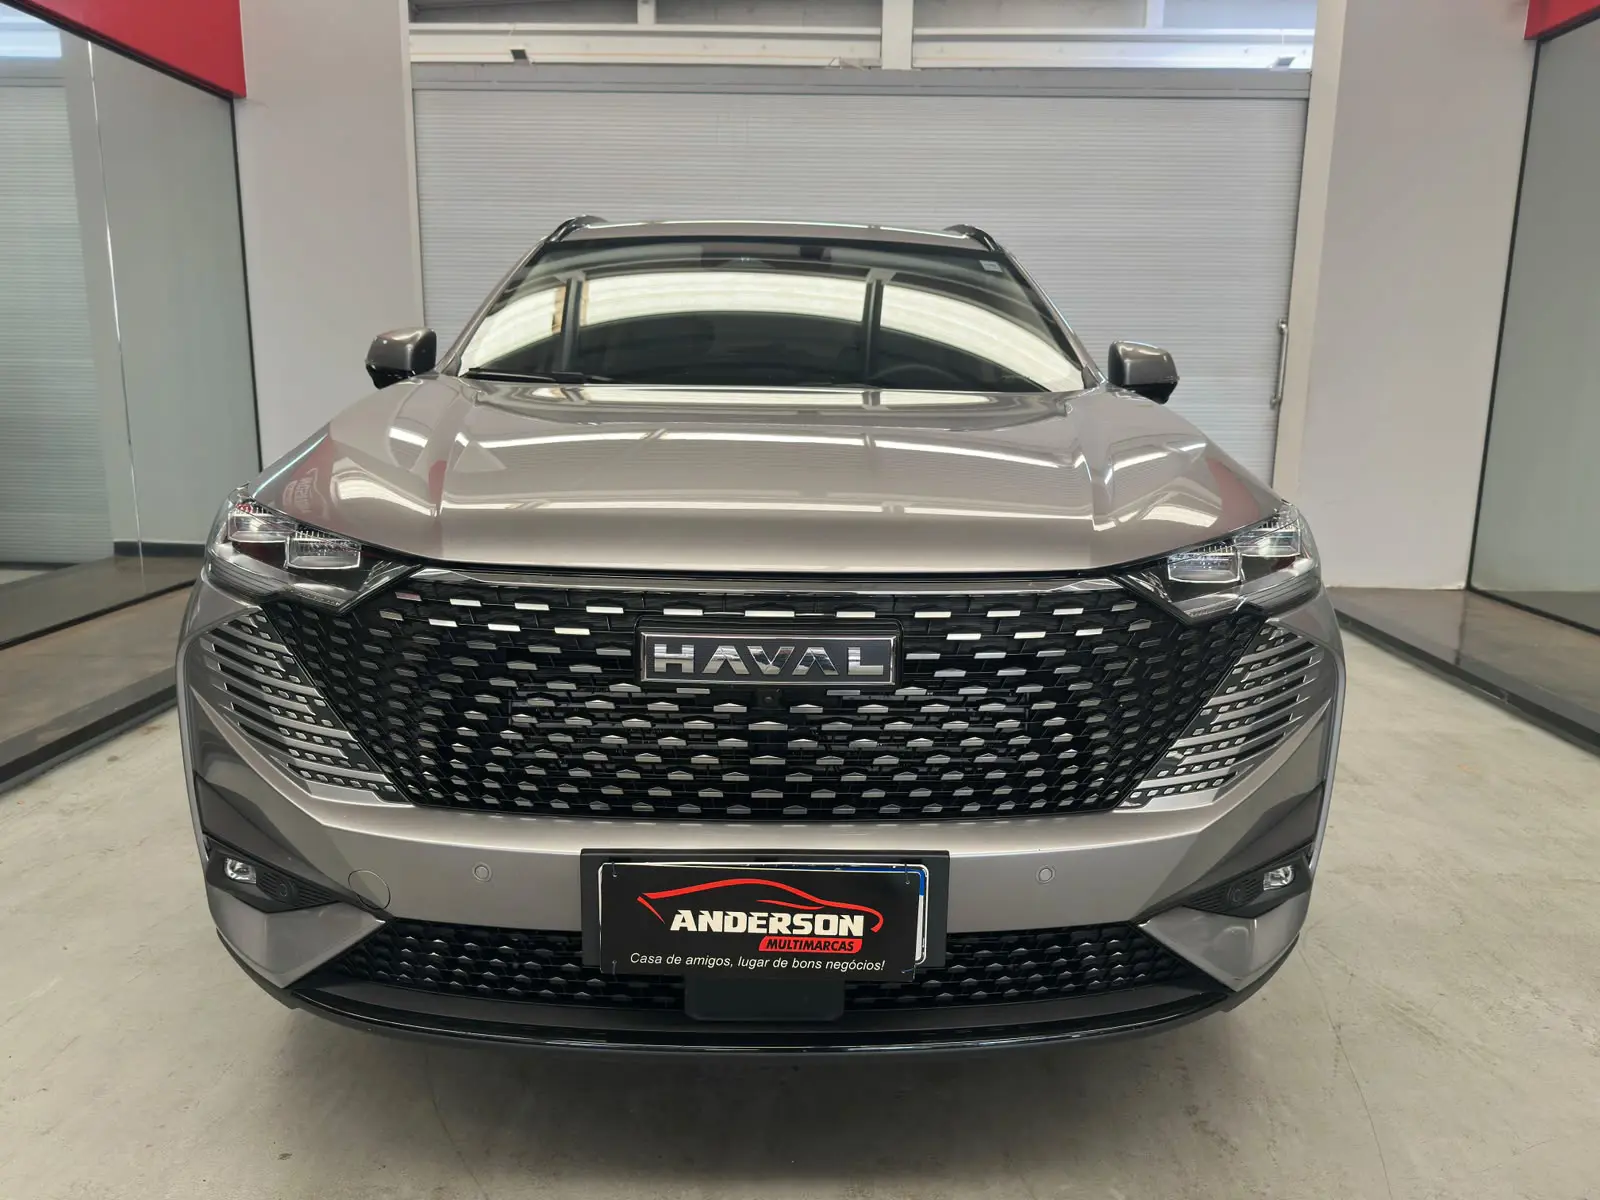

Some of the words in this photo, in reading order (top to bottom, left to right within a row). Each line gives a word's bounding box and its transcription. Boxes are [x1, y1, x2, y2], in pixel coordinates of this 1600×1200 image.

[654, 643, 884, 676] HAVAL
[670, 909, 864, 937] ANDERSON
[766, 938, 855, 953] MULTIMARCAS
[630, 953, 662, 963] Casa
[666, 954, 681, 964] de
[685, 955, 734, 969] amigos,
[737, 956, 770, 969] lugar
[773, 956, 788, 968] de
[792, 957, 822, 969] bons
[826, 959, 885, 972] negócios!
